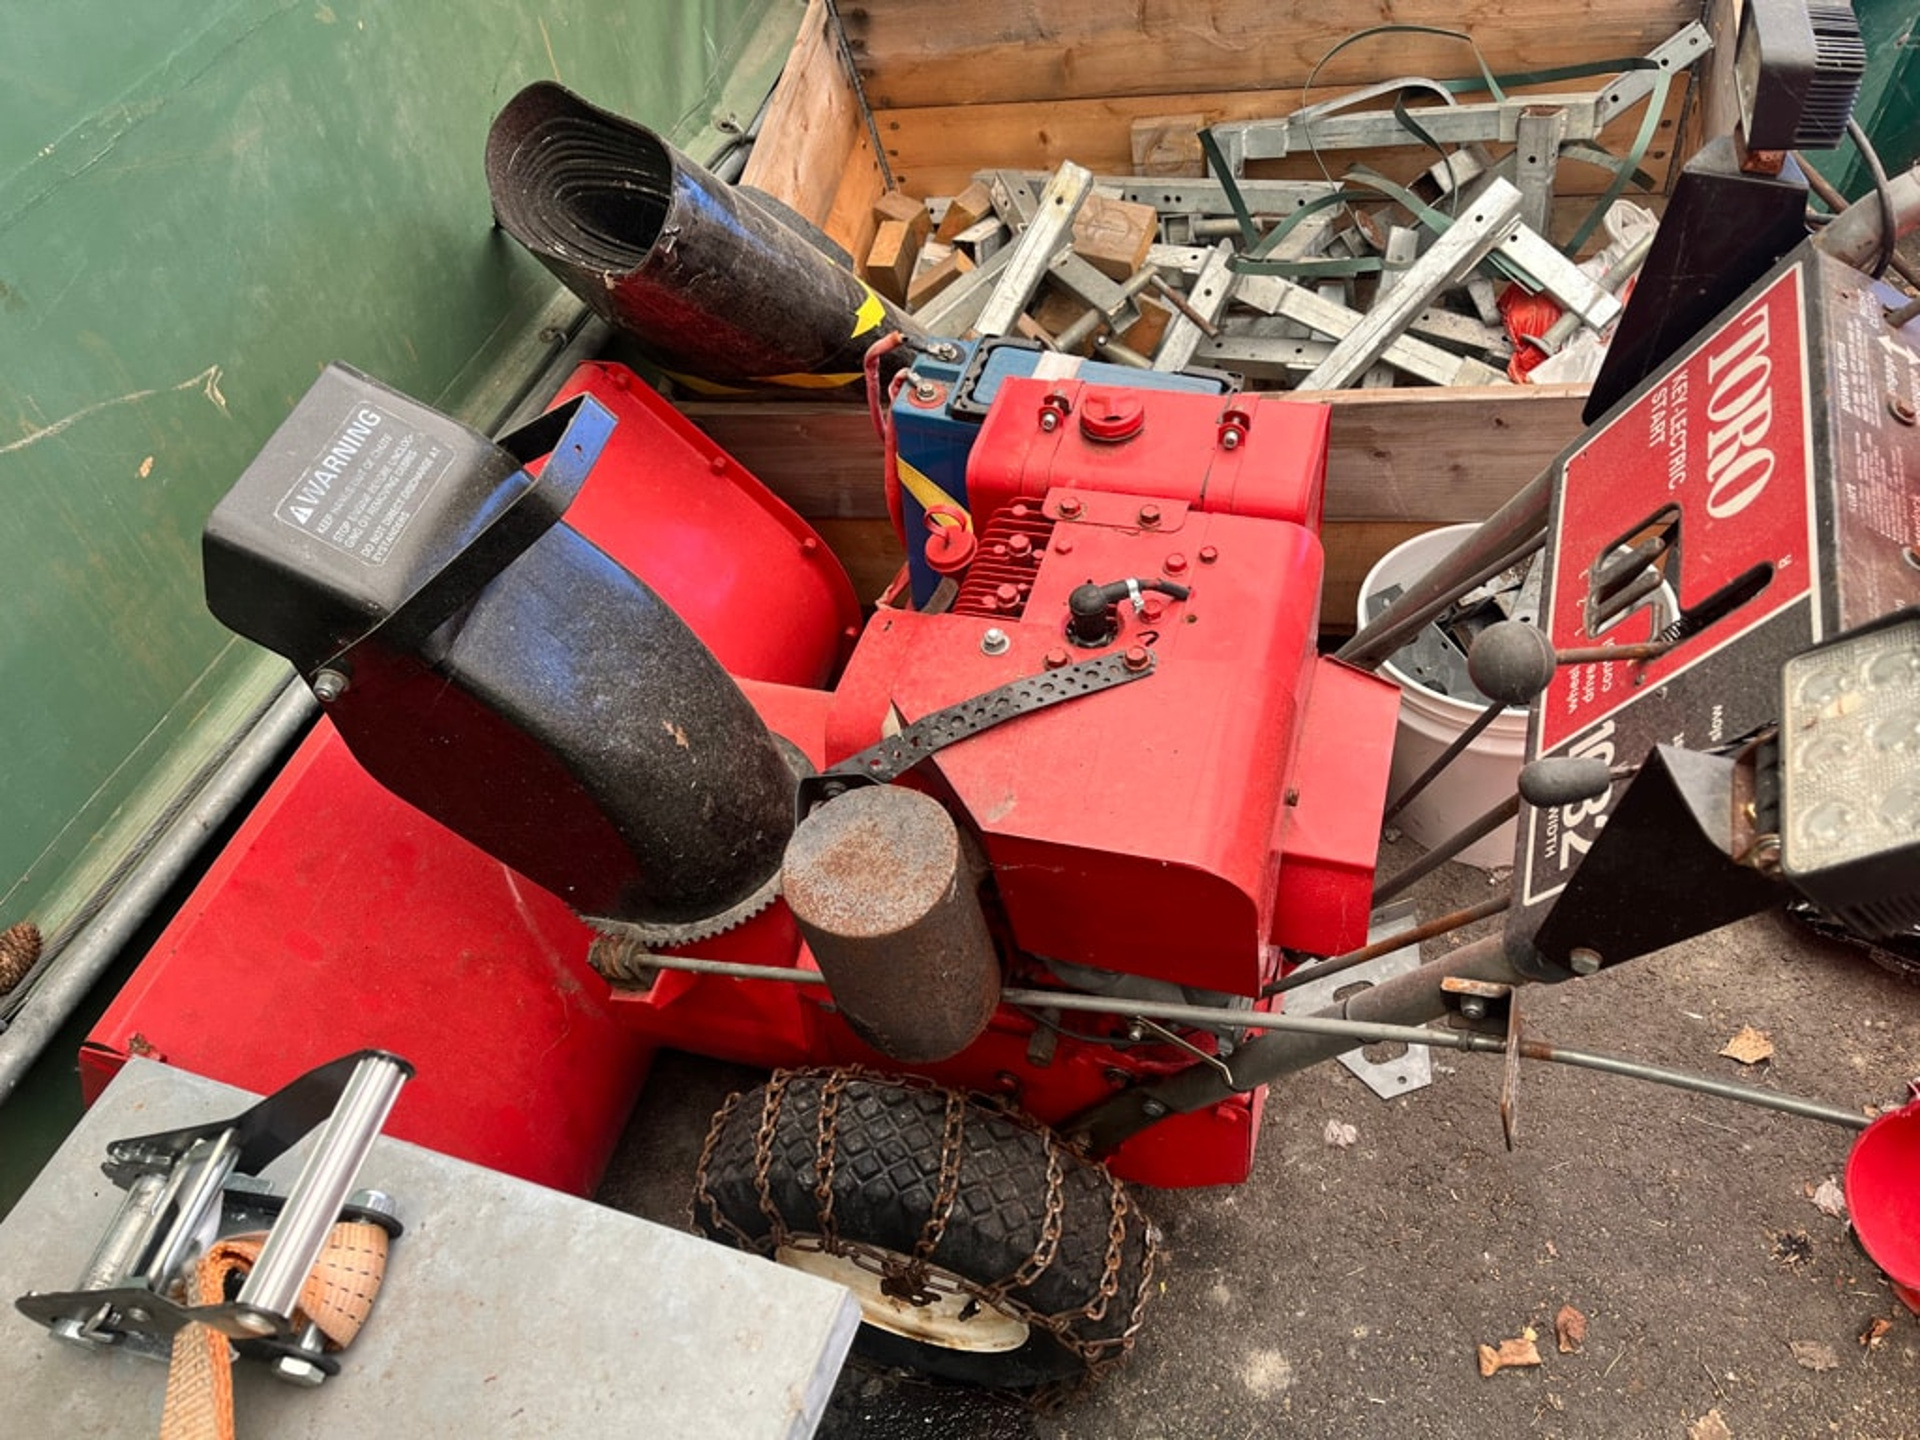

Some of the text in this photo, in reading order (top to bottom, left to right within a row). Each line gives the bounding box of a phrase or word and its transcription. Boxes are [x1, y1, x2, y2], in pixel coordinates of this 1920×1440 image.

[1650, 387, 1668, 447] START
[1668, 369, 1688, 491] KEY-LECTRIC
[1706, 303, 1775, 518] TORO
[297, 408, 382, 505] WARNING
[1778, 554, 1792, 569] R
[1566, 665, 1581, 715] wheel
[1582, 663, 1597, 703] drive
[1708, 705, 1723, 741] slow
